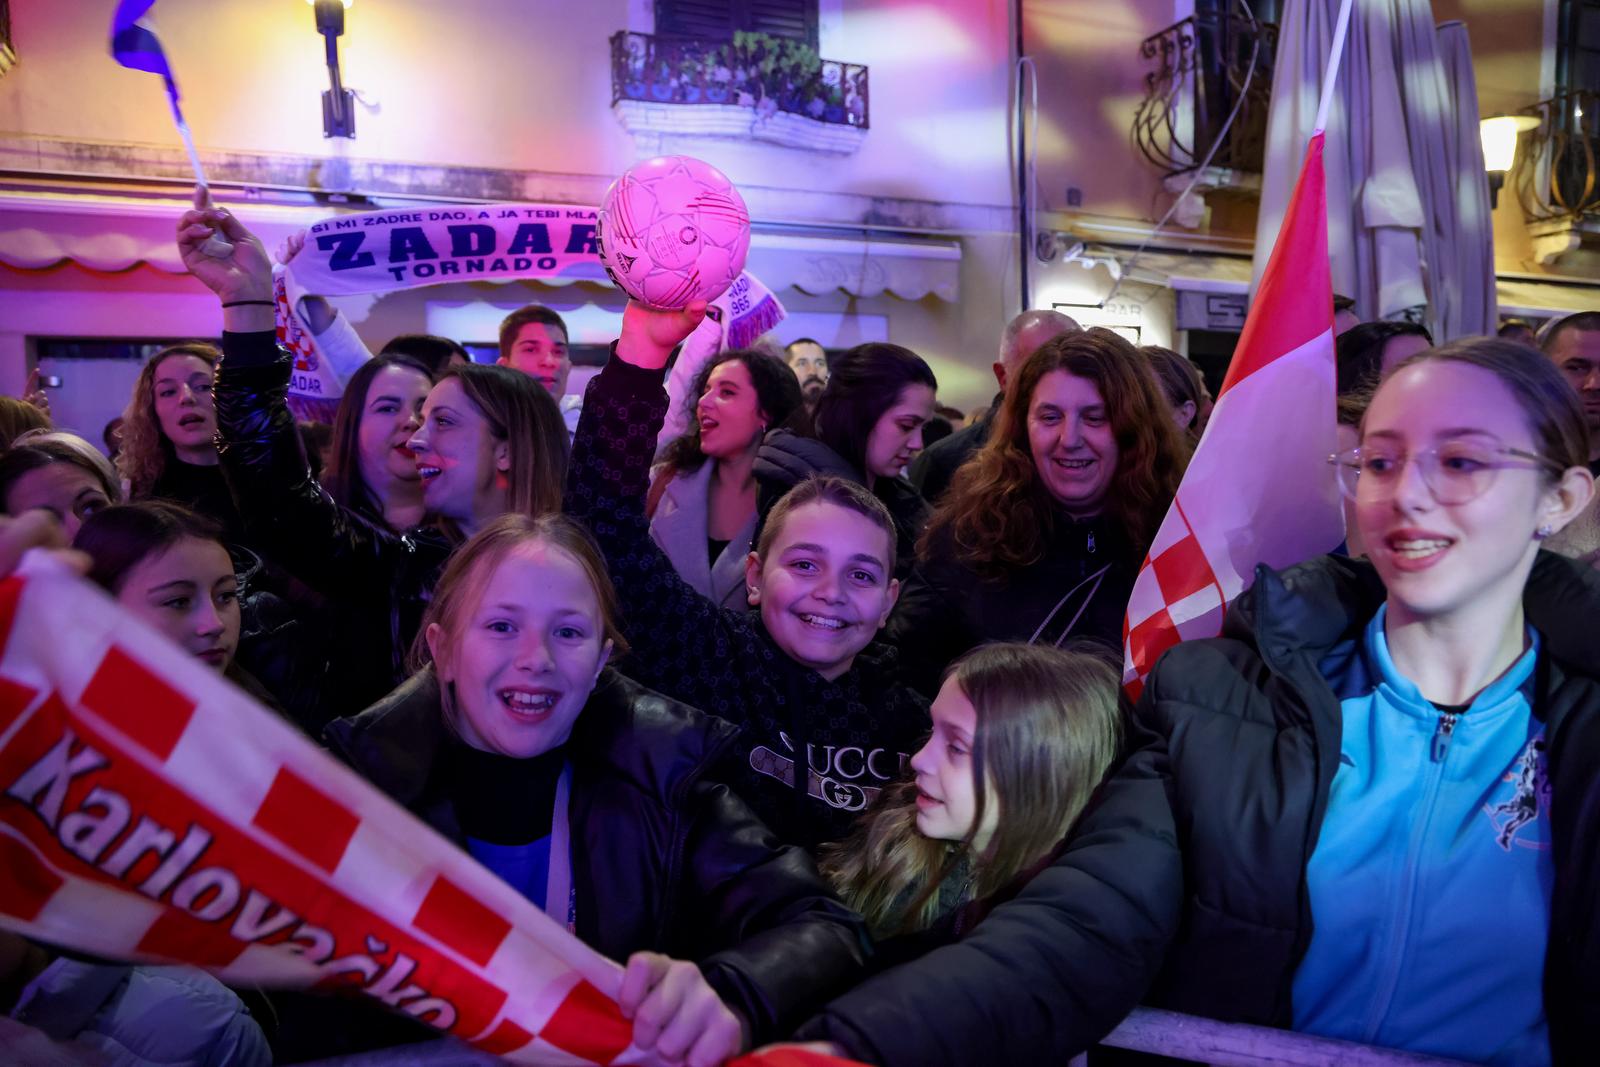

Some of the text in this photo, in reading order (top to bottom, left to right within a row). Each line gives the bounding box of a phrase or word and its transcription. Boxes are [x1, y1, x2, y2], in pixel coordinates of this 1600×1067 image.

[311, 223, 329, 233] SI
[336, 219, 357, 229] MI
[363, 213, 423, 226] ZADRE
[429, 211, 472, 221] DAO,
[478, 211, 490, 220] A
[497, 210, 518, 219] JA
[524, 210, 560, 219] TEBI
[316, 223, 598, 271] ZADAR
[388, 257, 557, 281] TORNADO
